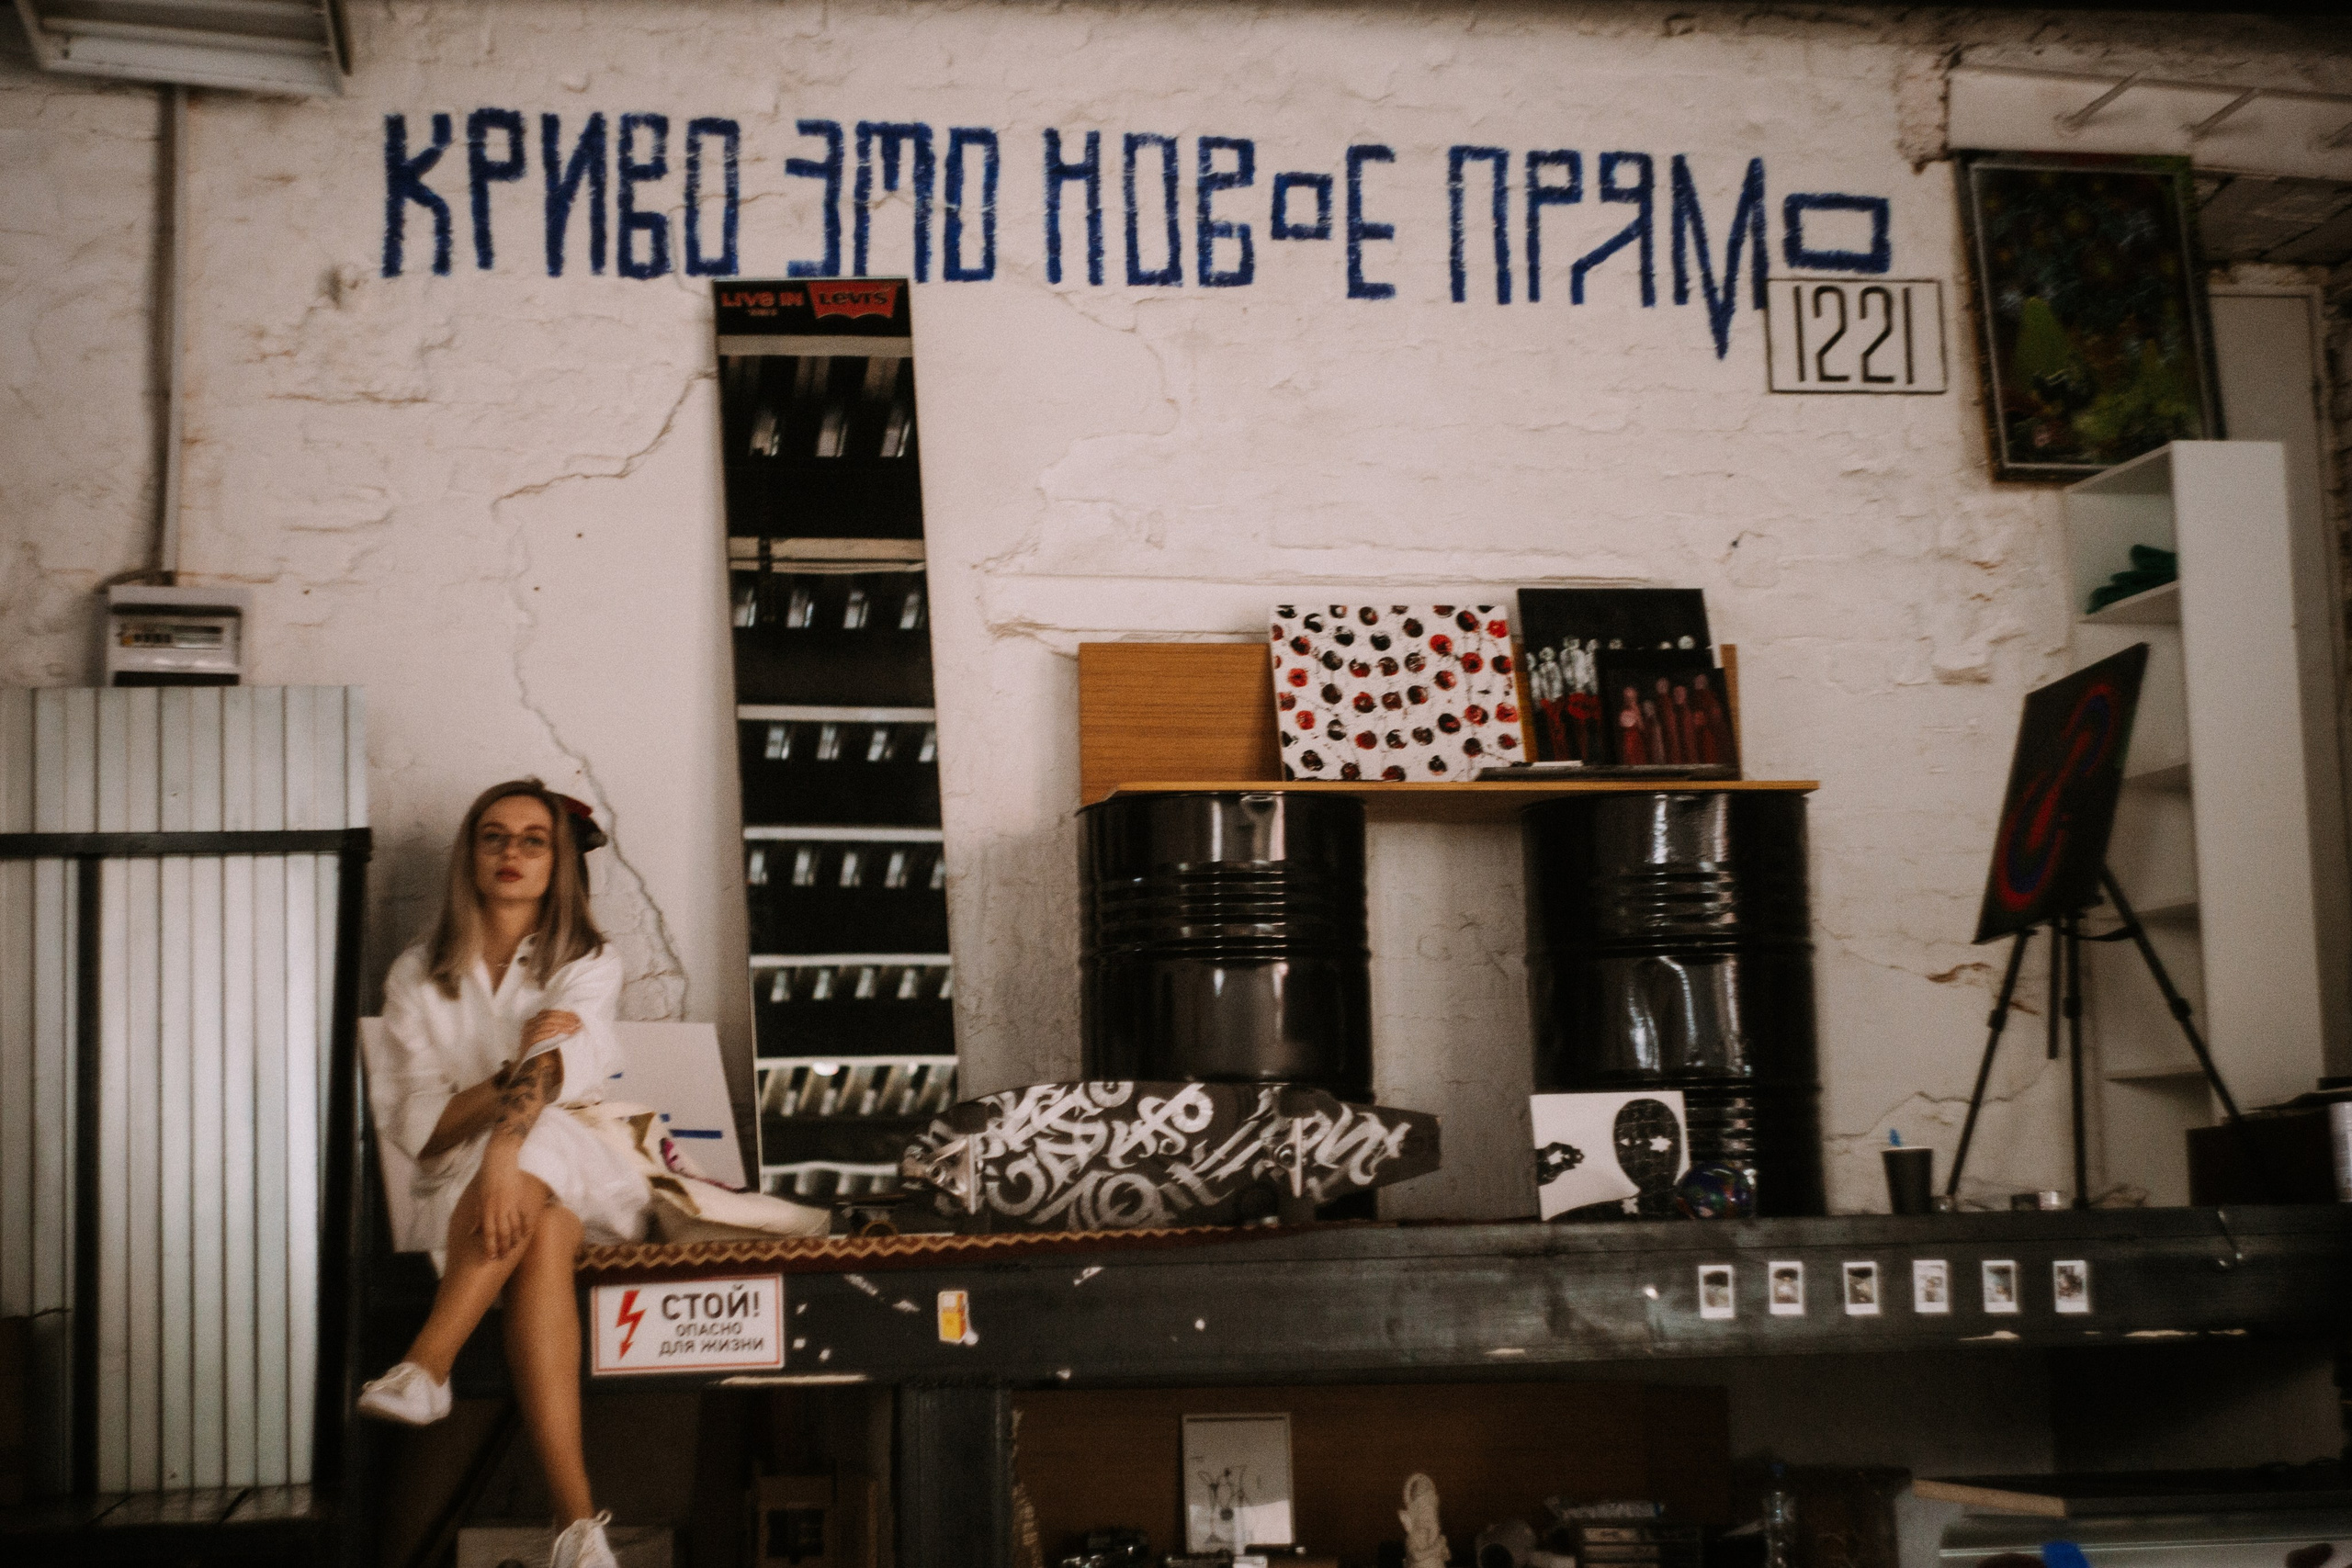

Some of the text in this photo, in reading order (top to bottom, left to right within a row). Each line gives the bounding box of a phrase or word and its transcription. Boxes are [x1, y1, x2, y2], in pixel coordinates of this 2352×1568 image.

[381, 108, 739, 278] КРИВО
[785, 118, 1000, 283] ЭТО
[1447, 144, 1891, 359] ПРЯМО
[1793, 285, 1914, 384] 1221
[662, 1283, 760, 1320] СТОЙ!
[659, 1337, 764, 1357] ДЛЯ ЖИЗНИ
[675, 1322, 742, 1337] ОПАСНО
